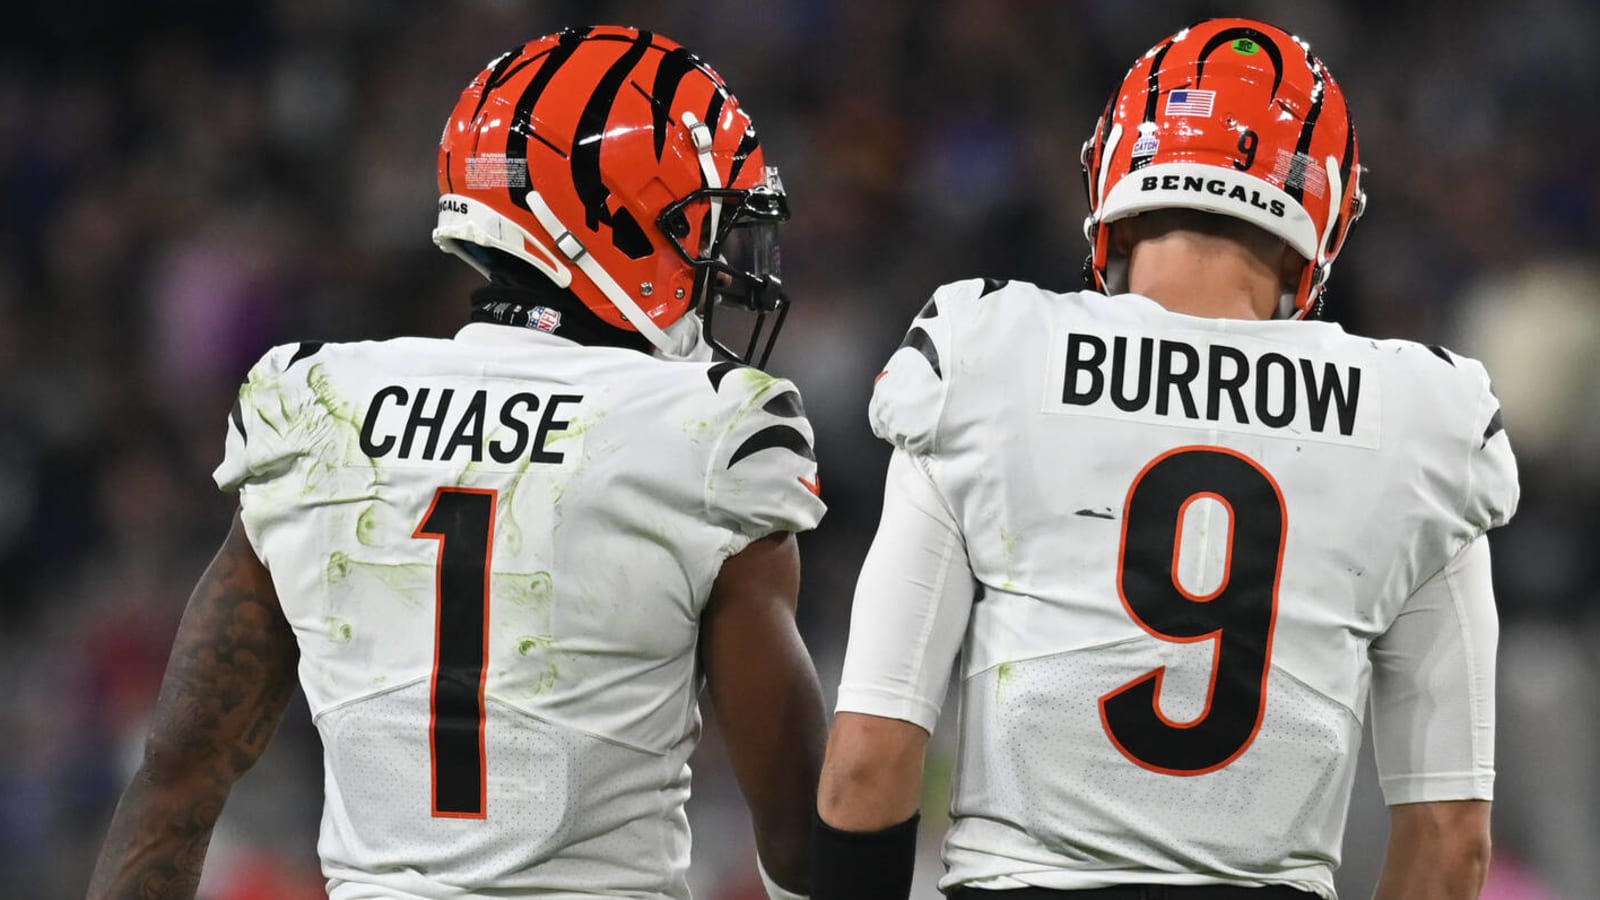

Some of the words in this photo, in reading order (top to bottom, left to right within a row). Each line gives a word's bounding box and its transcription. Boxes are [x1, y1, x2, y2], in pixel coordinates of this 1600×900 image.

[1140, 175, 1286, 218] BENGALS
[1233, 129, 1258, 172] 9
[358, 385, 584, 465] CHASE
[1062, 332, 1362, 437] BURROW
[411, 486, 498, 819] 1
[1098, 444, 1288, 777] 9
